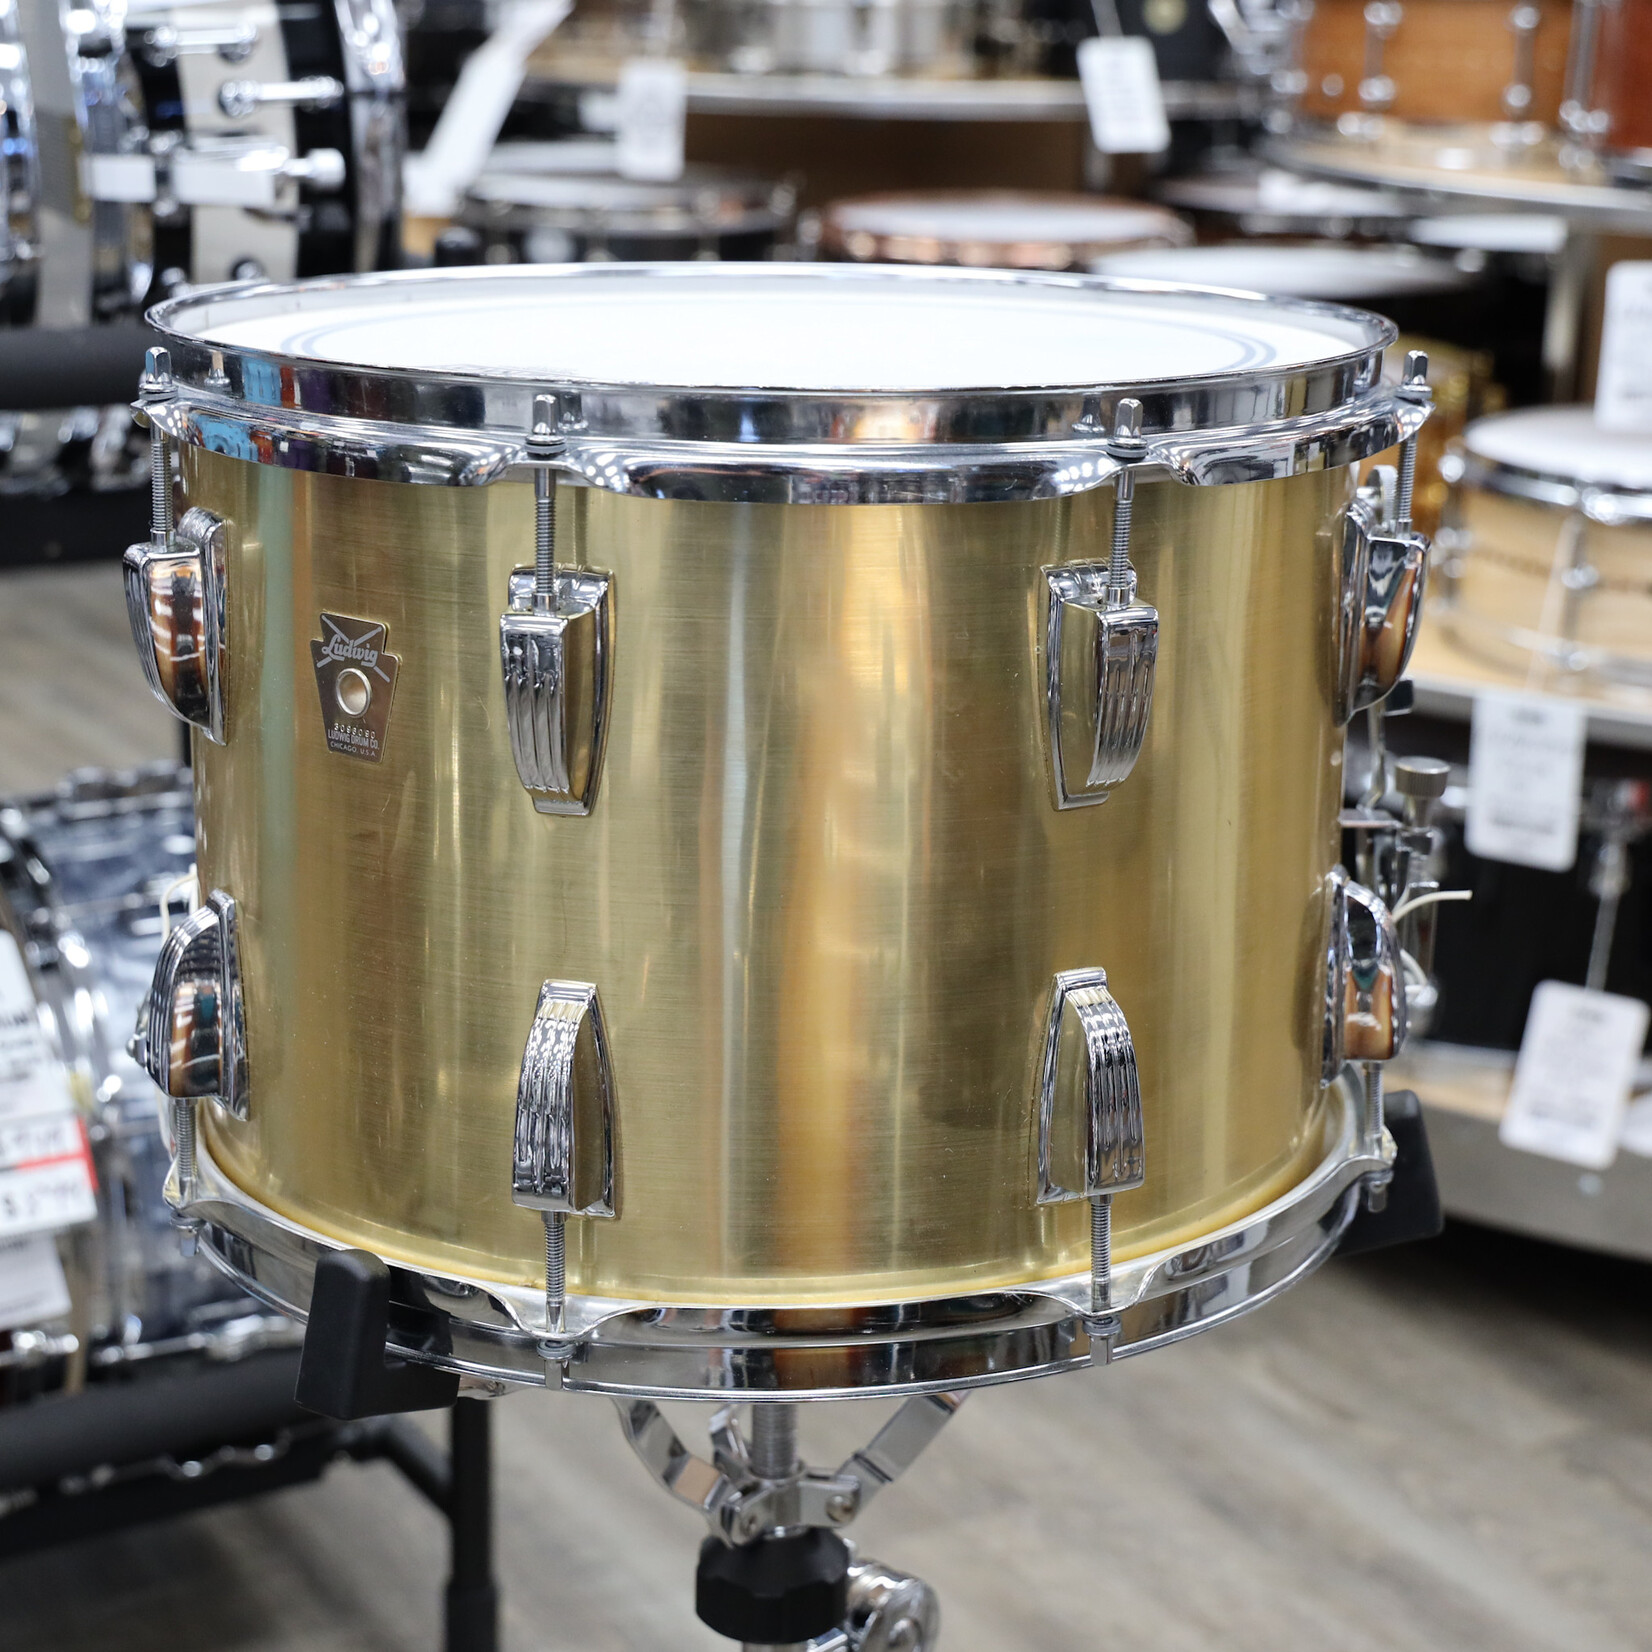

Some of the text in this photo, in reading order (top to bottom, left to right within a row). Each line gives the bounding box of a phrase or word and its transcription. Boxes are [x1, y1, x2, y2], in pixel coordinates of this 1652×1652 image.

[321, 634, 378, 667] Ludwig
[327, 728, 351, 743] LUDWIG
[350, 734, 369, 747] DRUM
